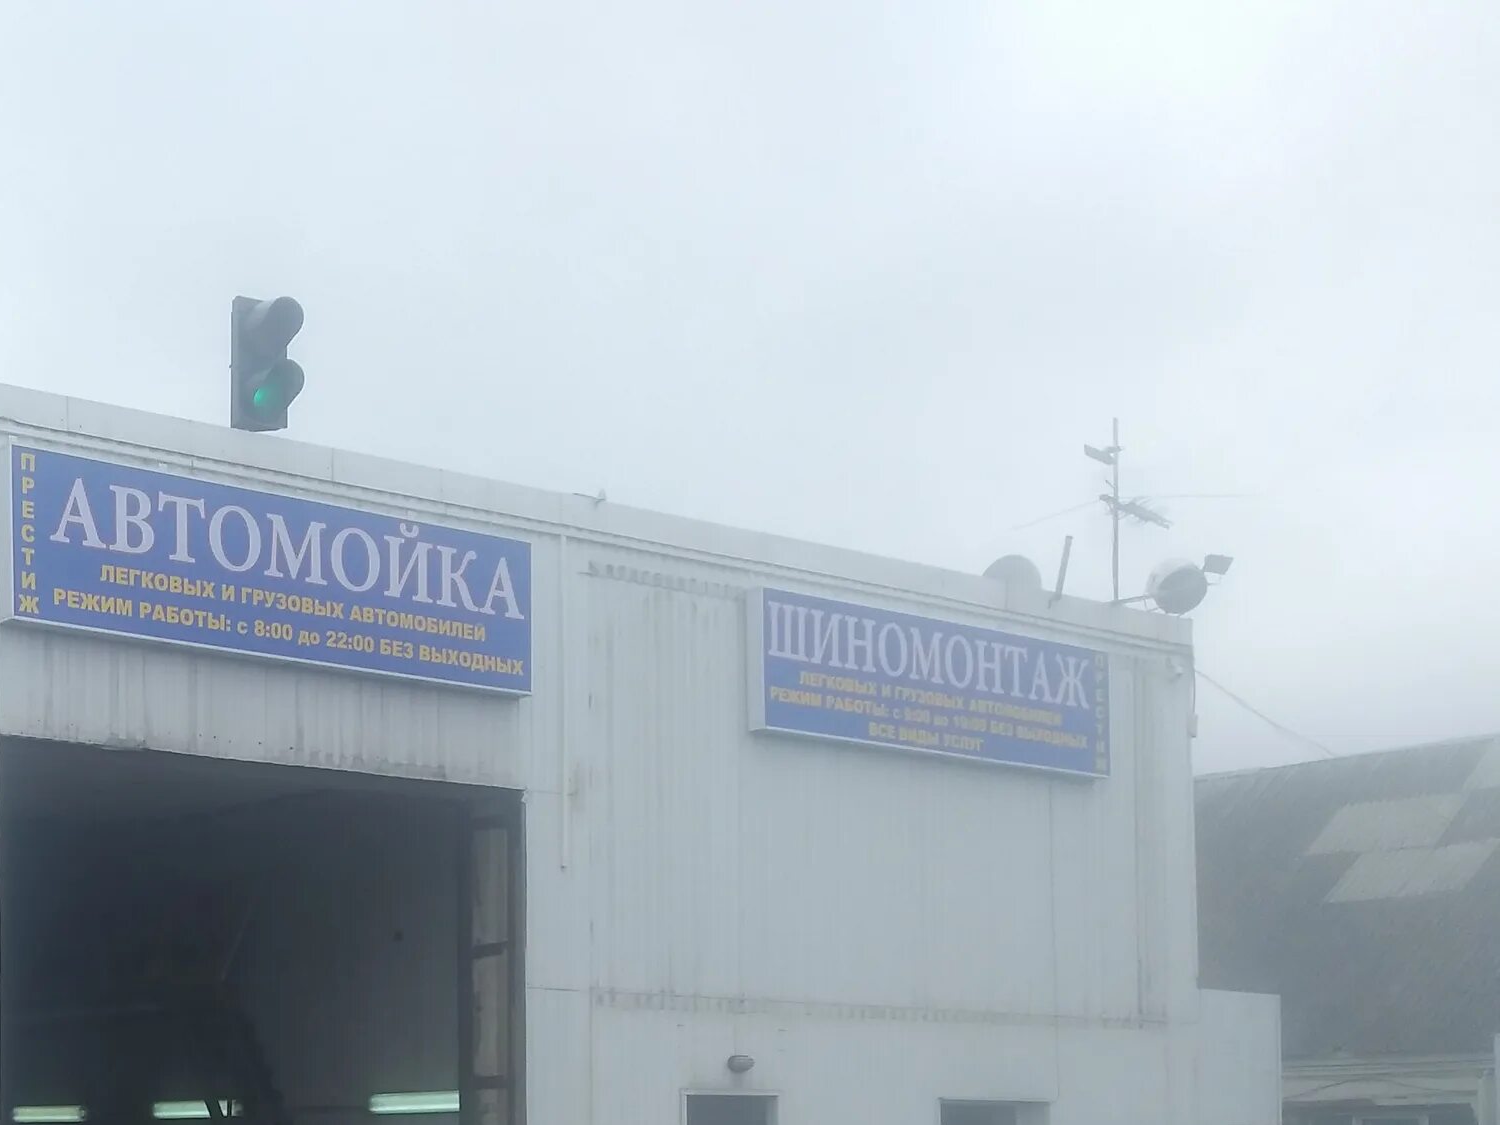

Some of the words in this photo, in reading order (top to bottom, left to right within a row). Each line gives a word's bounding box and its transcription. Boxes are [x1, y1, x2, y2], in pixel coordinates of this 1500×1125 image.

[19, 452, 40, 615] ПРЕСТИЖ
[49, 477, 525, 620] АВТОМОЙКА
[53, 587, 134, 617] РЕЖИМ
[139, 602, 232, 633] РАБОТЫ:
[236, 621, 248, 635] с
[253, 619, 294, 641] 8:00
[298, 629, 321, 647] до
[326, 629, 375, 654] 22:00
[379, 638, 415, 659] БЕЗ
[419, 644, 525, 677] ВЫХОДНЫХ
[100, 563, 216, 600] ЛЕГКОВЫХ
[221, 584, 236, 602] И
[241, 586, 345, 620] ГРУЗОВЫХ
[349, 602, 487, 642] АВТОМОБИЛЕЙ
[767, 600, 1090, 710] ШИНОМОНТАЖ
[770, 685, 822, 708] РЕЖИМ
[800, 671, 877, 696] ЛЕГКОВЫХ
[868, 721, 897, 740] ВСЕ
